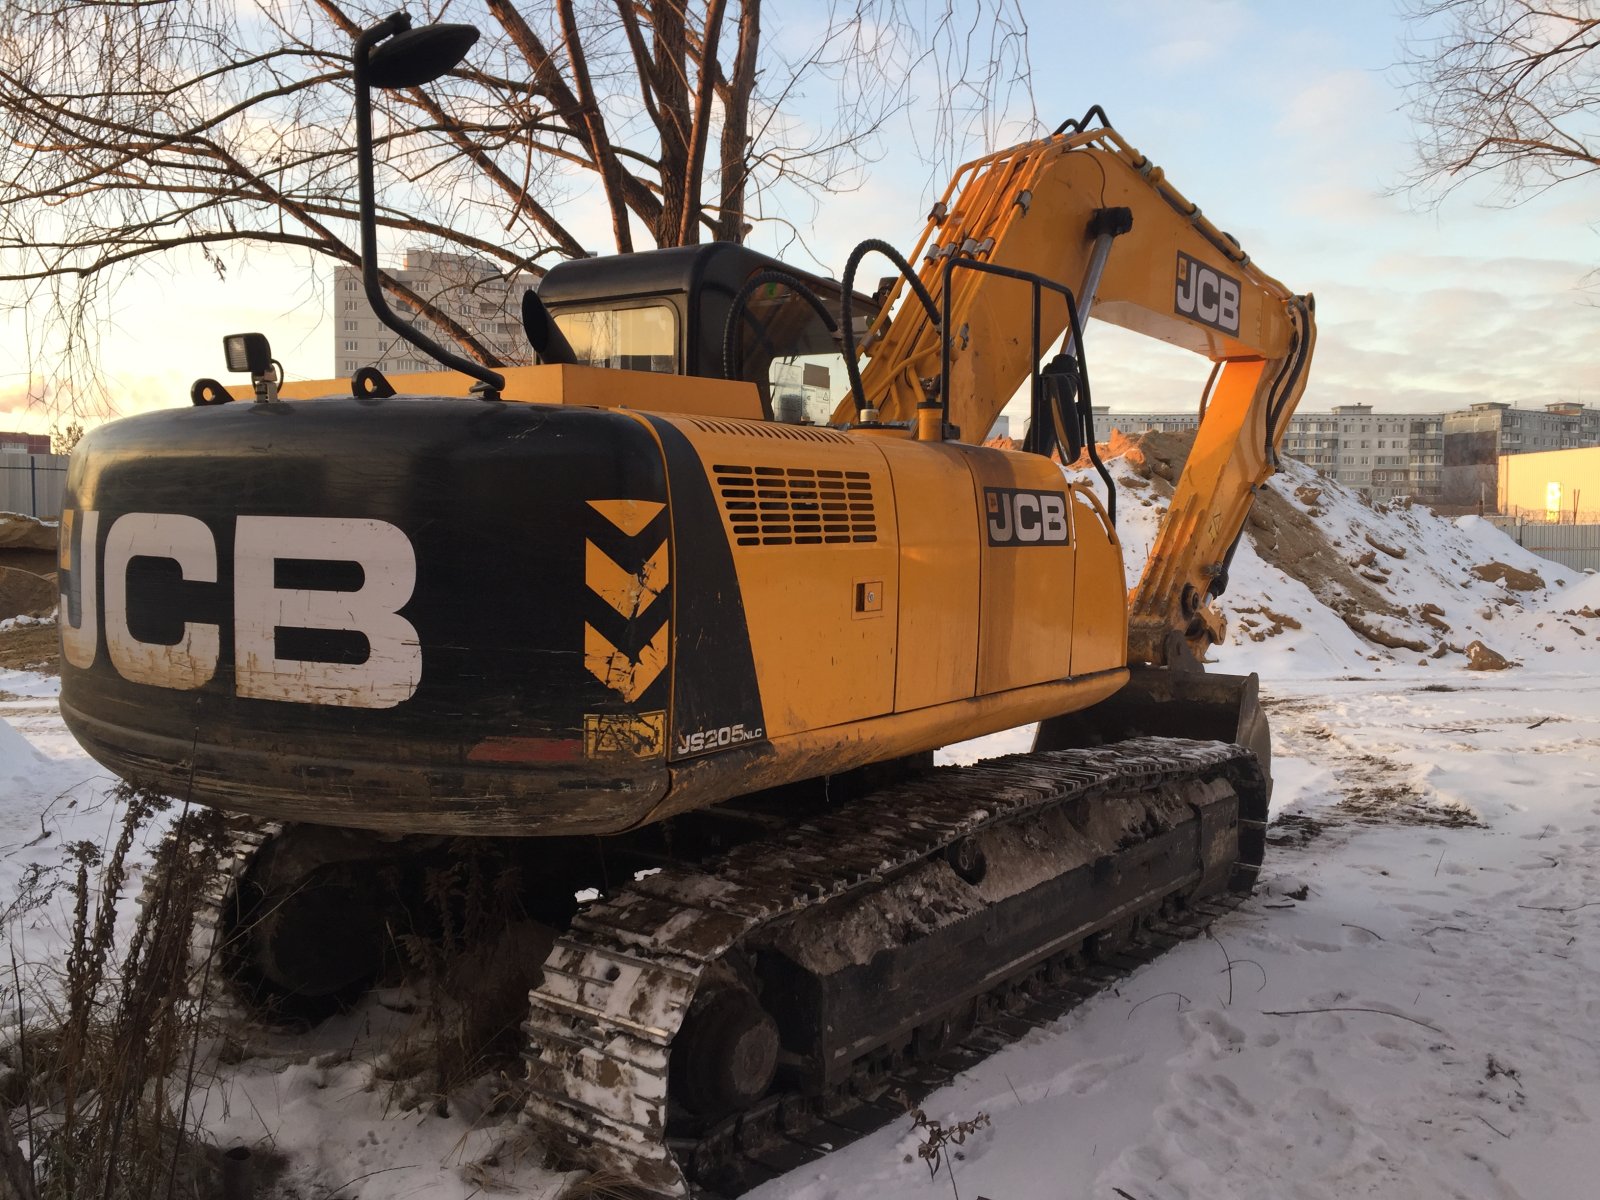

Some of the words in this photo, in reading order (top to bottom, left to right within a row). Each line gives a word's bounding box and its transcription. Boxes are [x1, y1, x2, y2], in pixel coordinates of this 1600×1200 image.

[1177, 262, 1240, 331] JCB
[988, 493, 1068, 542] JCB
[60, 510, 423, 709] JCB
